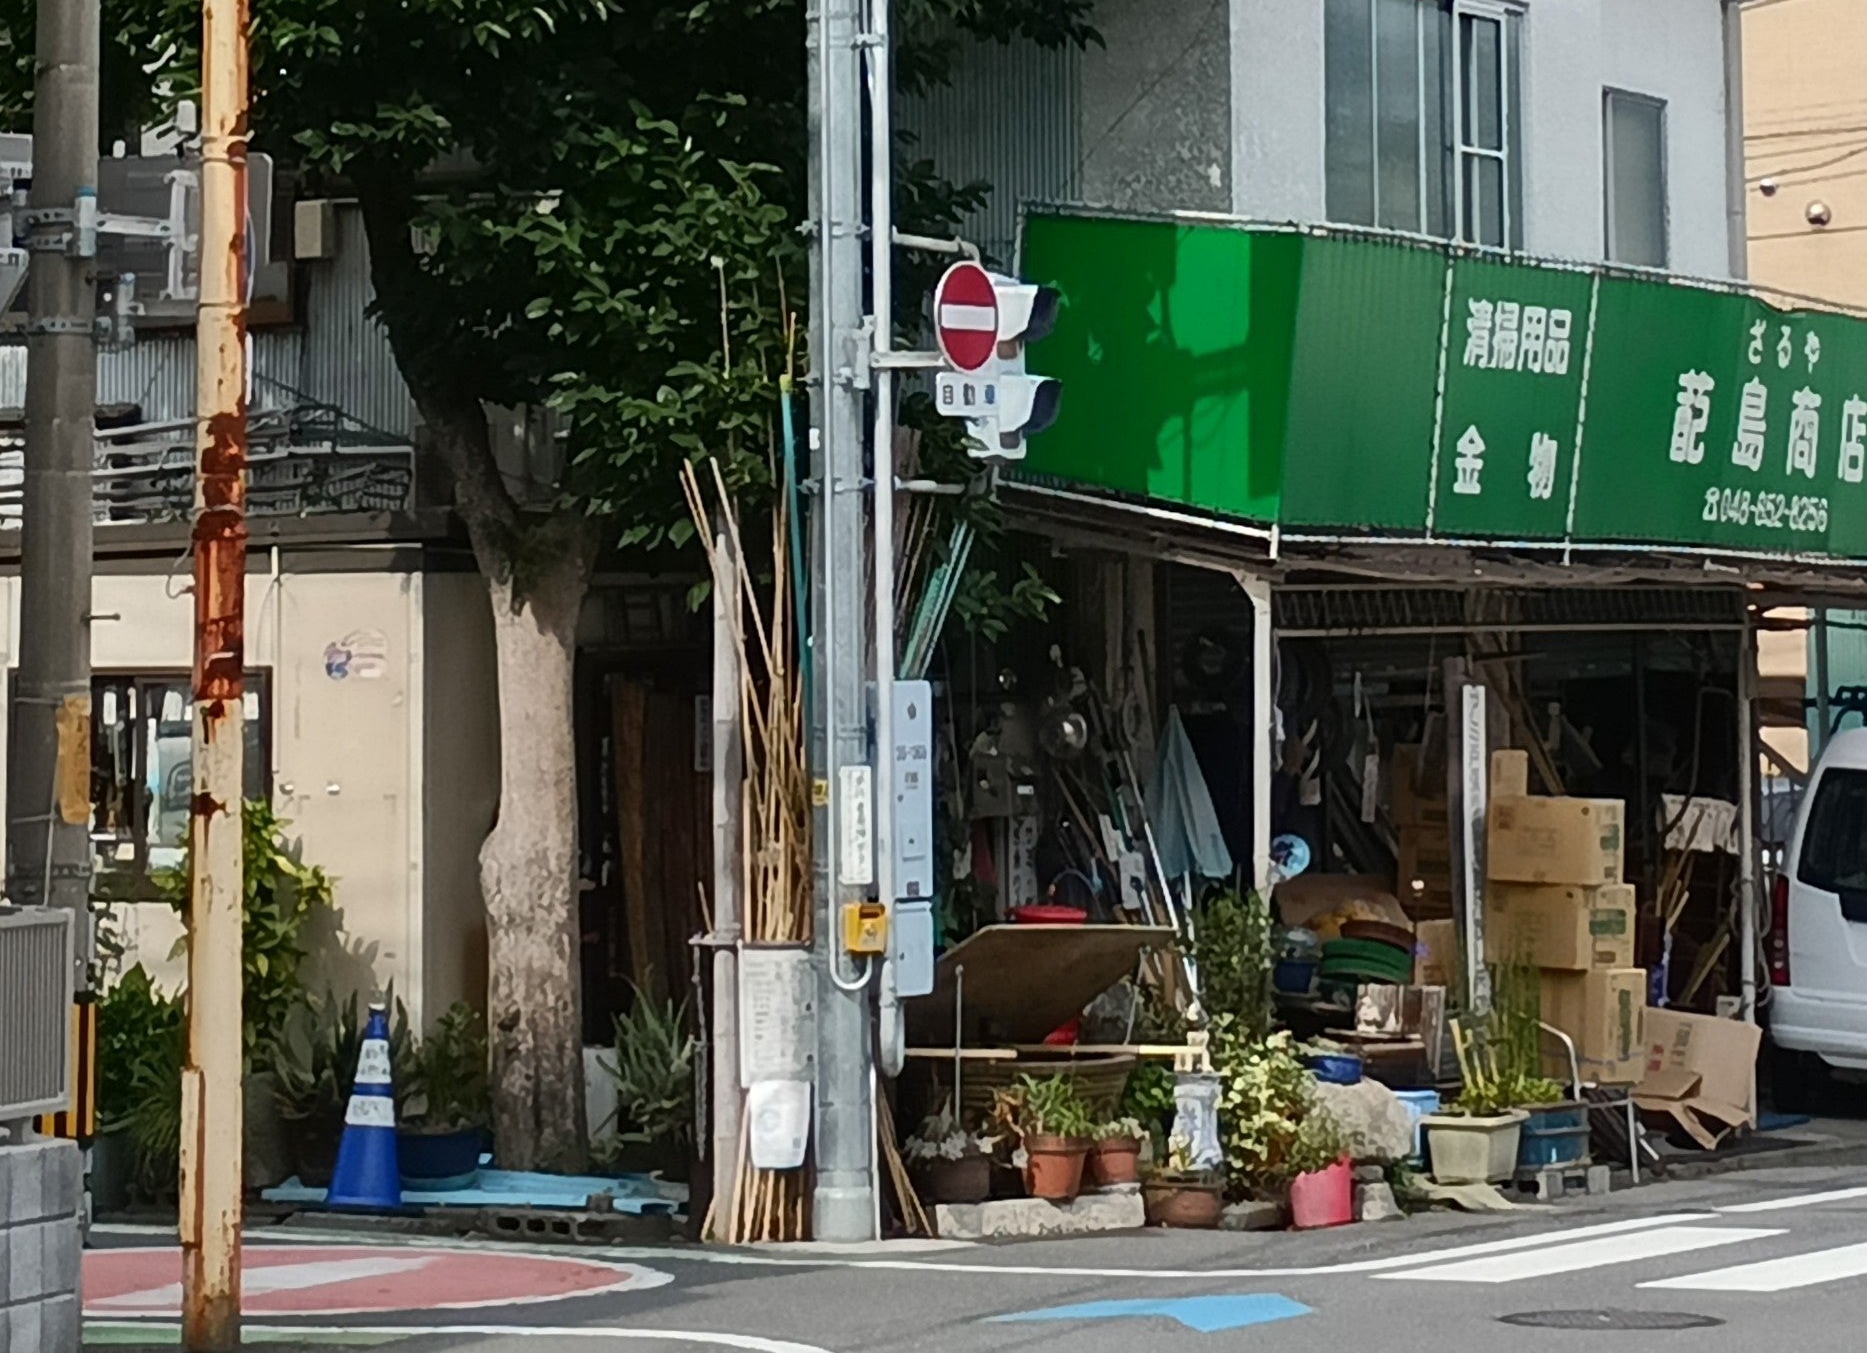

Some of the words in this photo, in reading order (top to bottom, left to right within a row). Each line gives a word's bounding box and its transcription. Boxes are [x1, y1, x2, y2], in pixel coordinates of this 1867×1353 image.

[1463, 297, 1572, 375] 清掃用品
[1748, 318, 1821, 374] さるや
[1453, 424, 1558, 500] 金物
